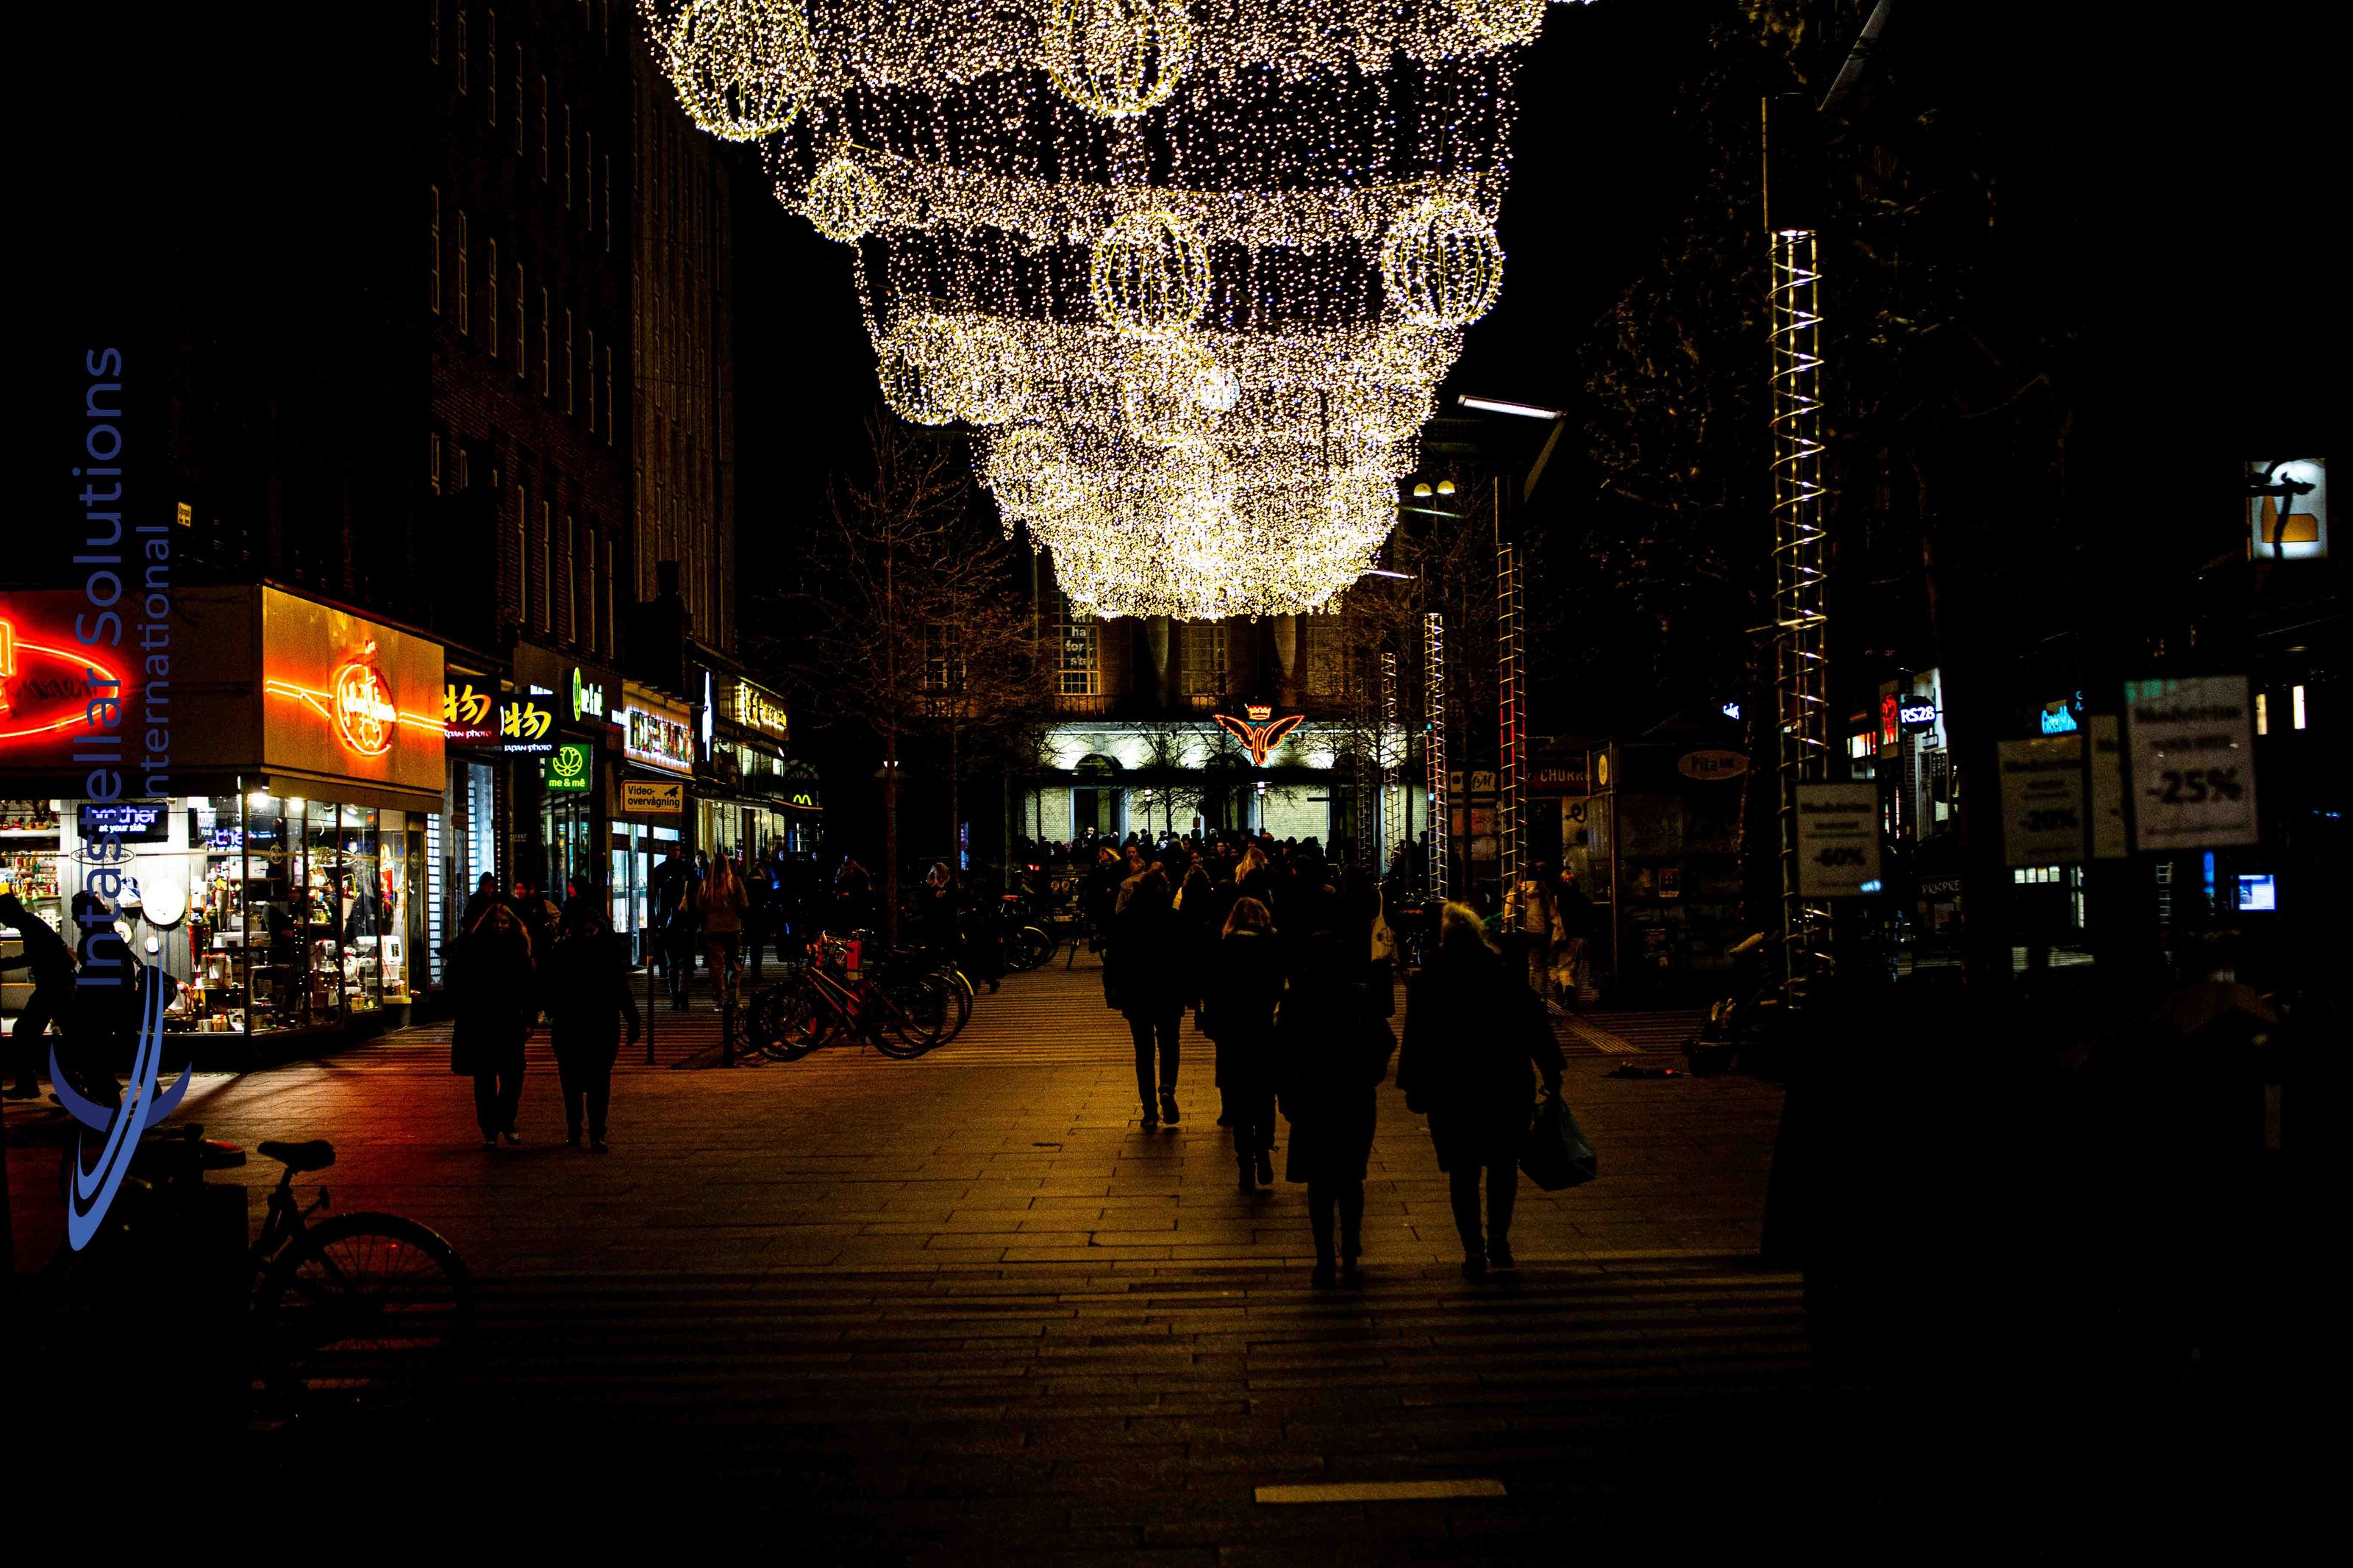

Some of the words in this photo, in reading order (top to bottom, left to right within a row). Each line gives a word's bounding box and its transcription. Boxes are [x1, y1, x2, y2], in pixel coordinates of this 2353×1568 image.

[1900, 706, 1935, 723] RS28
[549, 779, 563, 787] me
[564, 778, 571, 787] &
[2146, 767, 2243, 803] -25%
[627, 785, 655, 795] Video-
[627, 795, 680, 808] overvågning
[99, 824, 109, 832] at
[110, 824, 129, 834] your
[129, 823, 147, 831] side
